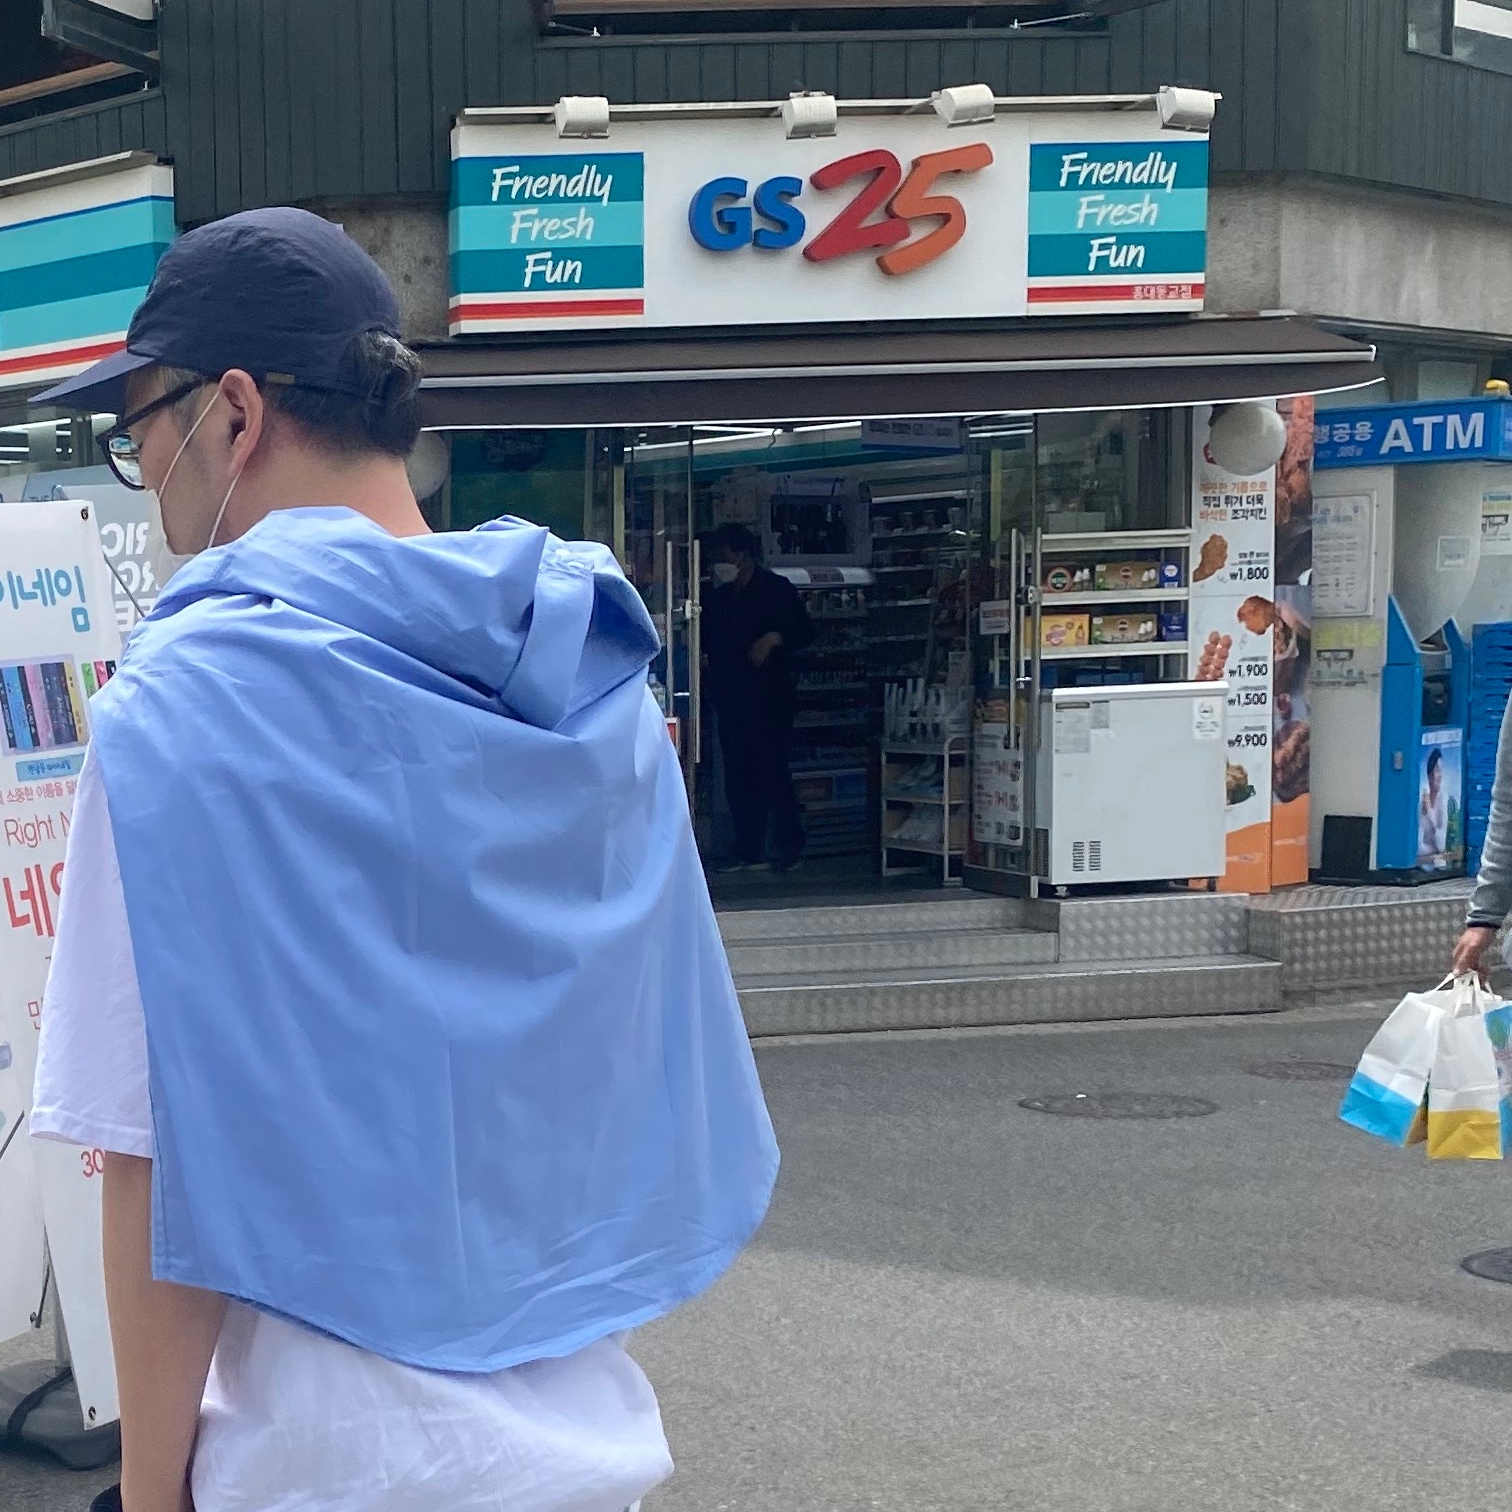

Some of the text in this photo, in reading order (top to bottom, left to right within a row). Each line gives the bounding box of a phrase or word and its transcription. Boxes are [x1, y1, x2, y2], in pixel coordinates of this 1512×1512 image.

[491, 164, 614, 207] Friendly
[1059, 152, 1178, 193] Friendly
[510, 206, 595, 245] Fresh
[689, 142, 995, 276] GS25
[1077, 194, 1160, 230] Fresh
[524, 251, 583, 288] Fun
[1088, 237, 1146, 272] Fun
[1379, 412, 1486, 455] ATM
[4, 815, 56, 849] Right
